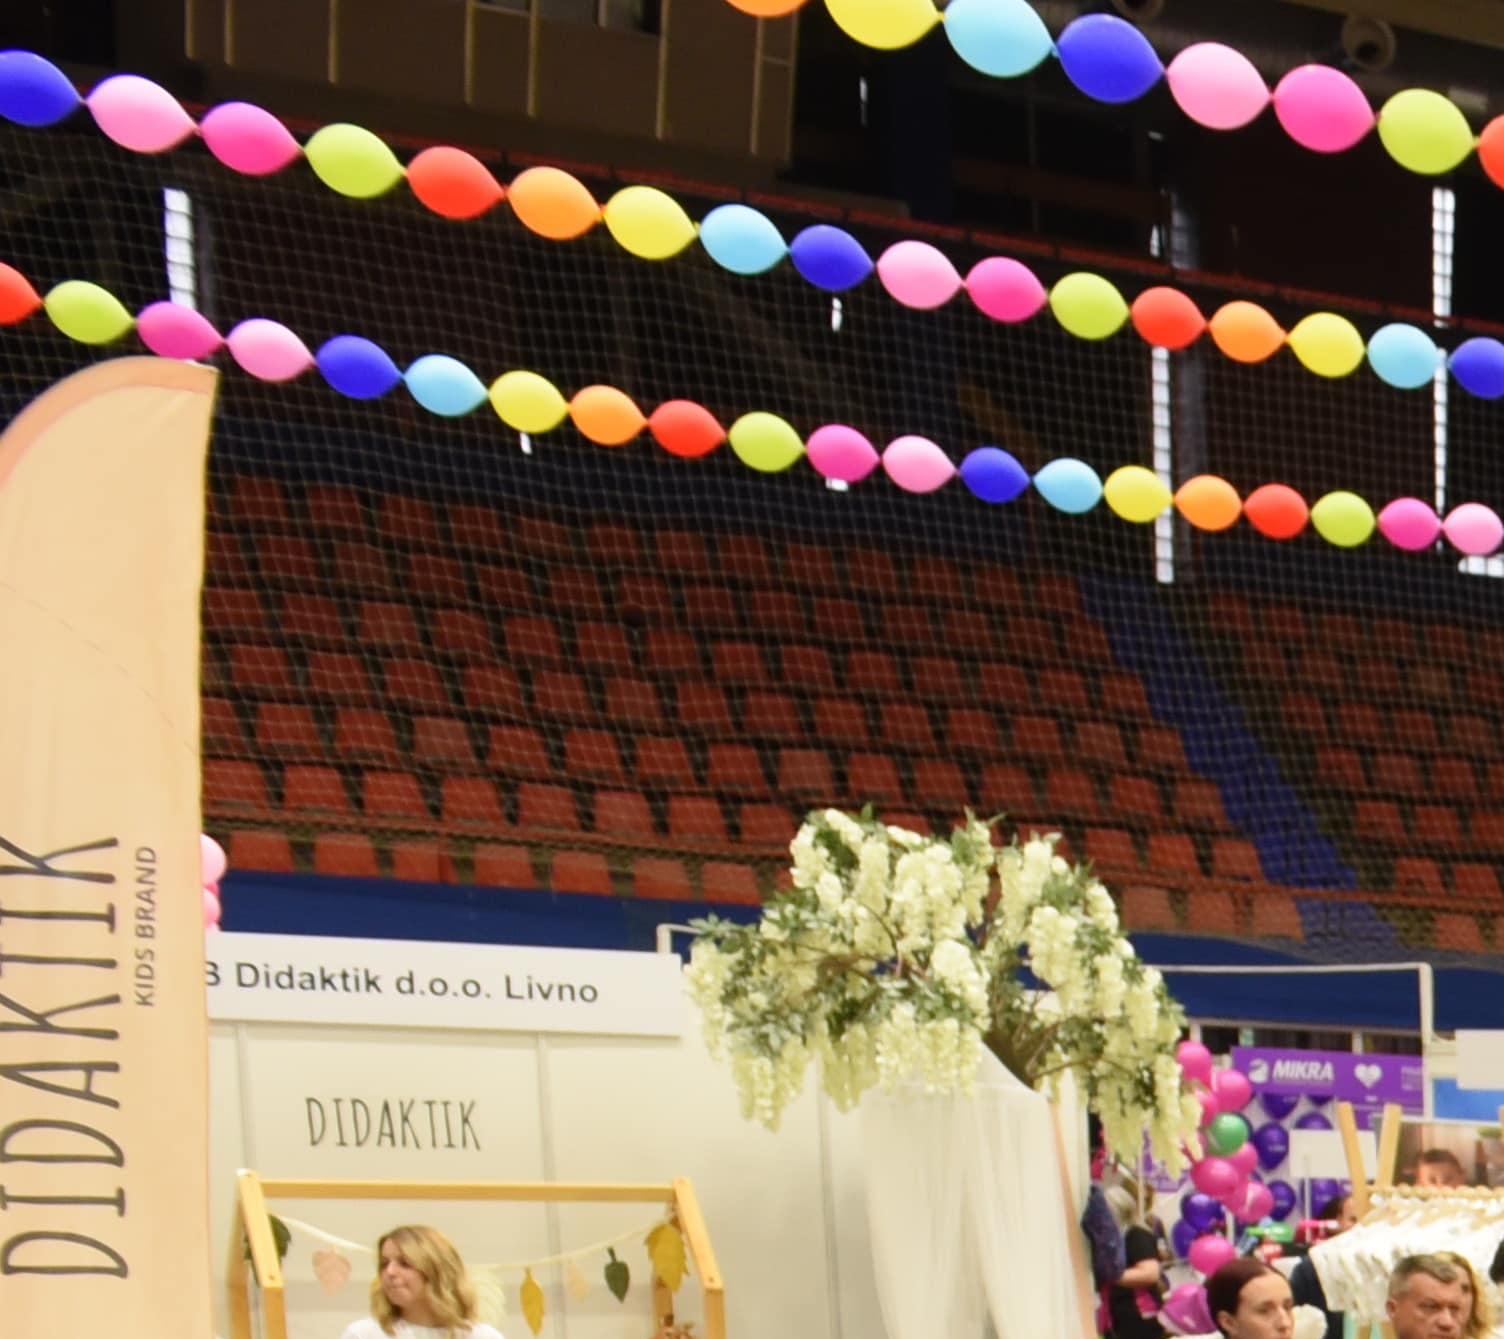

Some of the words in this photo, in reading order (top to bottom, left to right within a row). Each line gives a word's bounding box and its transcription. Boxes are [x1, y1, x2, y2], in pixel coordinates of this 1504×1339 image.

[135, 846, 157, 940] BRAND
[134, 947, 155, 1007] KIDS
[235, 963, 382, 995] Didaktik
[395, 966, 491, 998] d.o.o.
[505, 973, 599, 1005] Livno
[0, 838, 129, 1280] DIDAKTIK
[1272, 1060, 1335, 1081] MIKRA
[304, 1096, 483, 1152] DIDAKTIK
